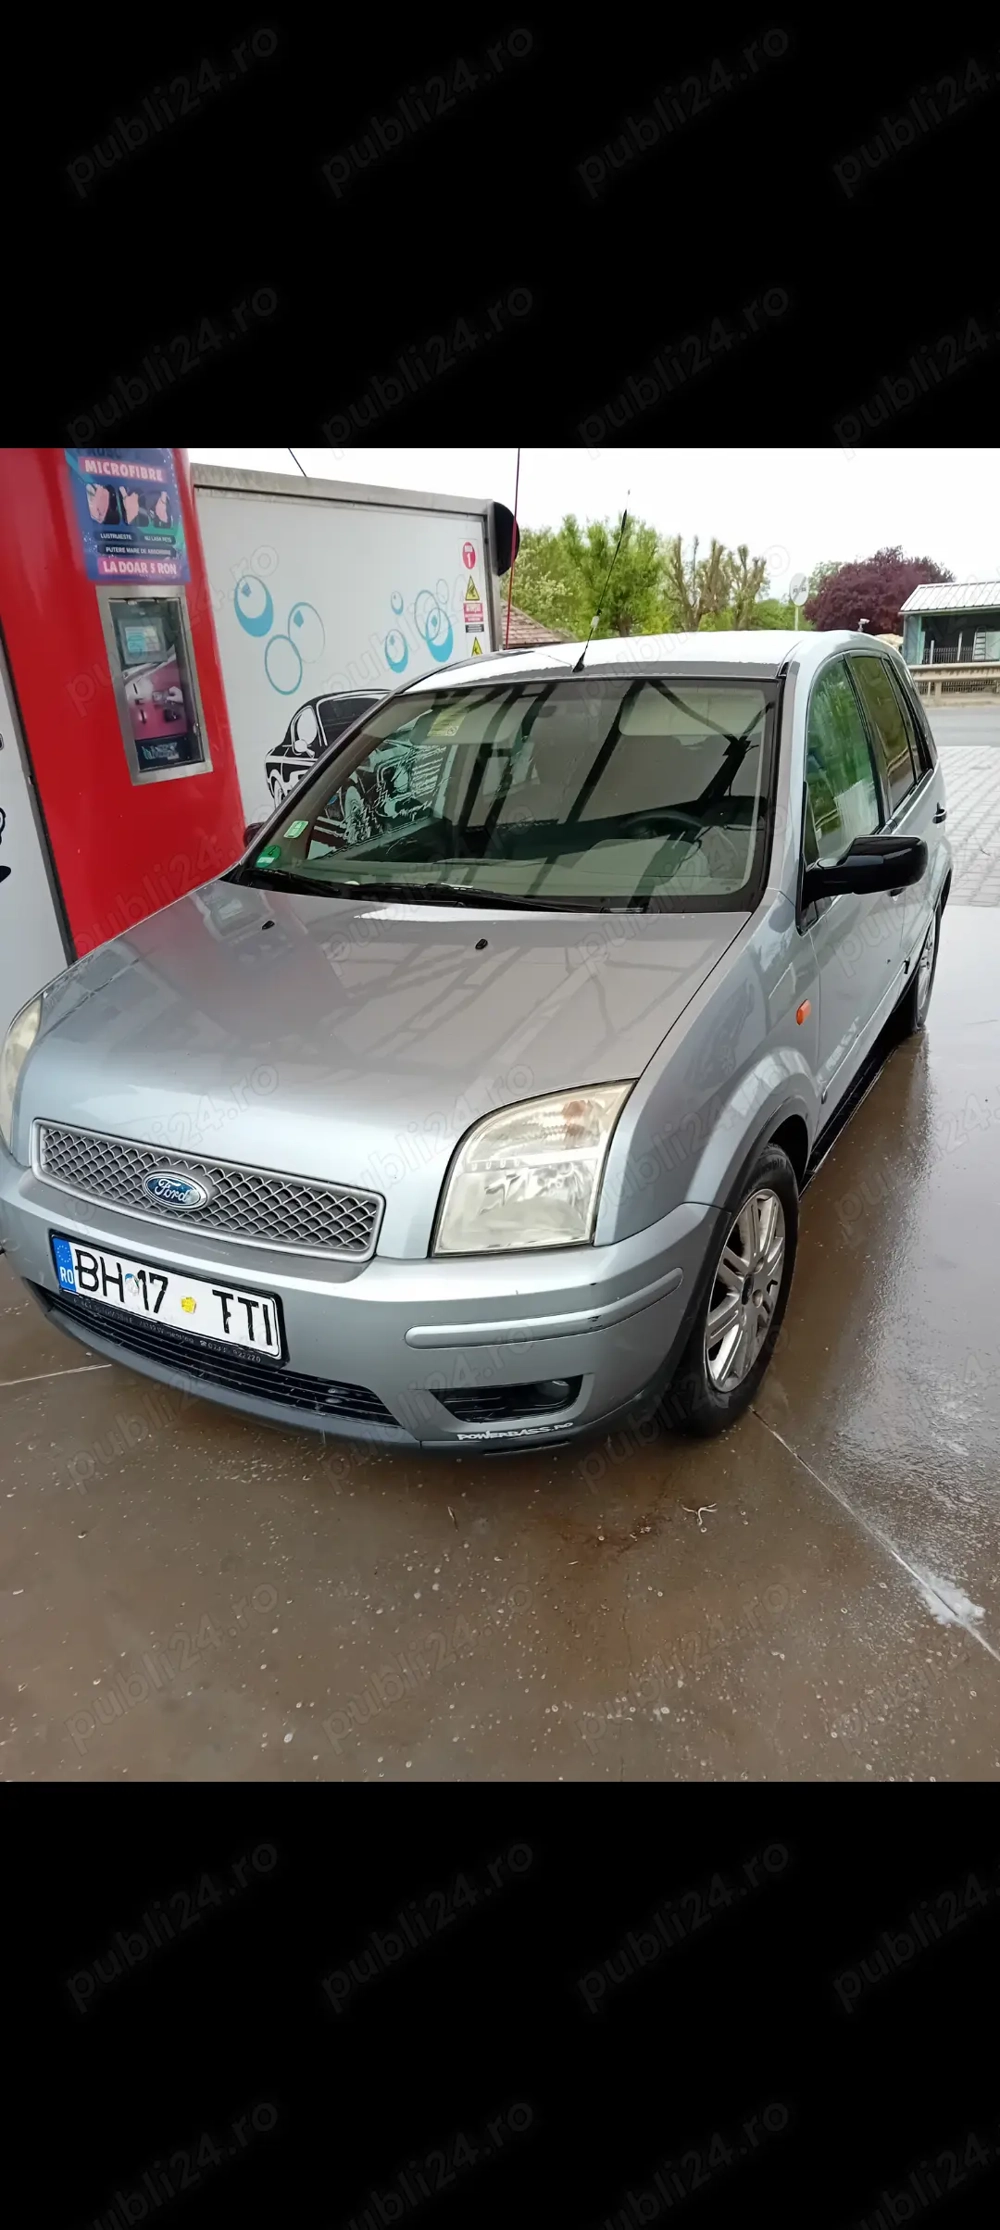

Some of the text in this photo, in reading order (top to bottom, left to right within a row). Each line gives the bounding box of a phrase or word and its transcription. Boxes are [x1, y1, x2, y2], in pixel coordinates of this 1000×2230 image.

[85, 460, 163, 481] MICROFIBRE
[103, 561, 177, 575] LA DOAR 5 RON
[154, 1179, 192, 1202] Ford
[59, 1266, 74, 1285] RO
[74, 1249, 125, 1303] BH
[137, 1269, 169, 1314] 17
[212, 1289, 273, 1347] TTI
[457, 1422, 573, 1440] POWERBASS.RO
